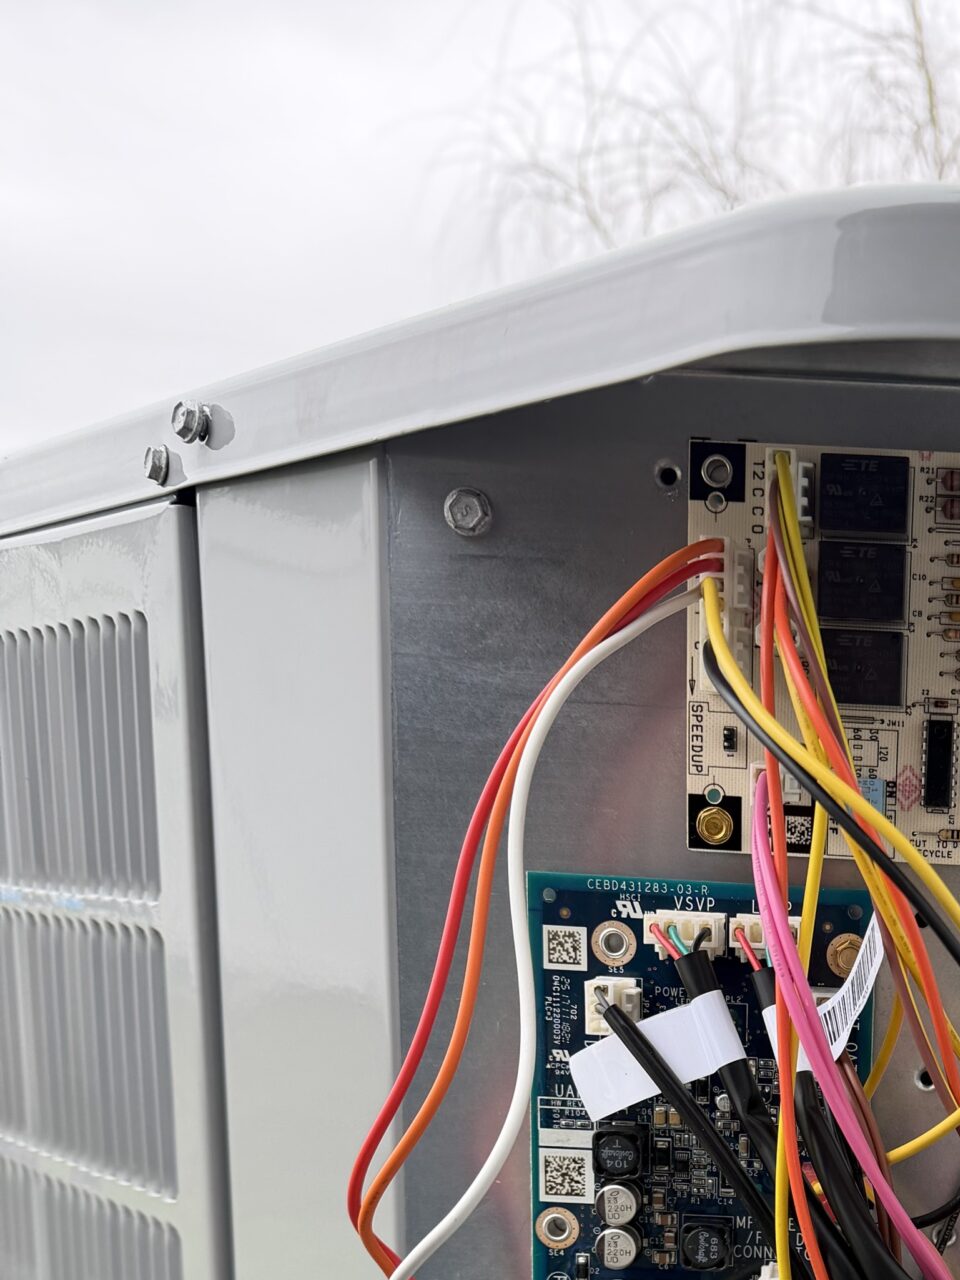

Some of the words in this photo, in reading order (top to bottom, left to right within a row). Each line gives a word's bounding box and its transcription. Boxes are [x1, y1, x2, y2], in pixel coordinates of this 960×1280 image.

[752, 460, 766, 481] T2
[919, 467, 935, 475] R21
[752, 488, 765, 498] C
[919, 495, 935, 503] R22
[752, 506, 764, 516] C
[691, 703, 703, 774] SPEEDUP
[879, 746, 889, 762] 120
[868, 768, 878, 780] 60
[886, 781, 897, 798] ON
[936, 839, 948, 848] TO
[586, 879, 709, 895] CEBD431283-03-R
[674, 895, 716, 912] VSVP
[570, 1004, 578, 1020] 702
[566, 1100, 583, 1108] REV
[605, 1160, 629, 1170] 104
[606, 1204, 633, 1213] 220H
[605, 1248, 632, 1257] 220H
[710, 1237, 719, 1259] 683
